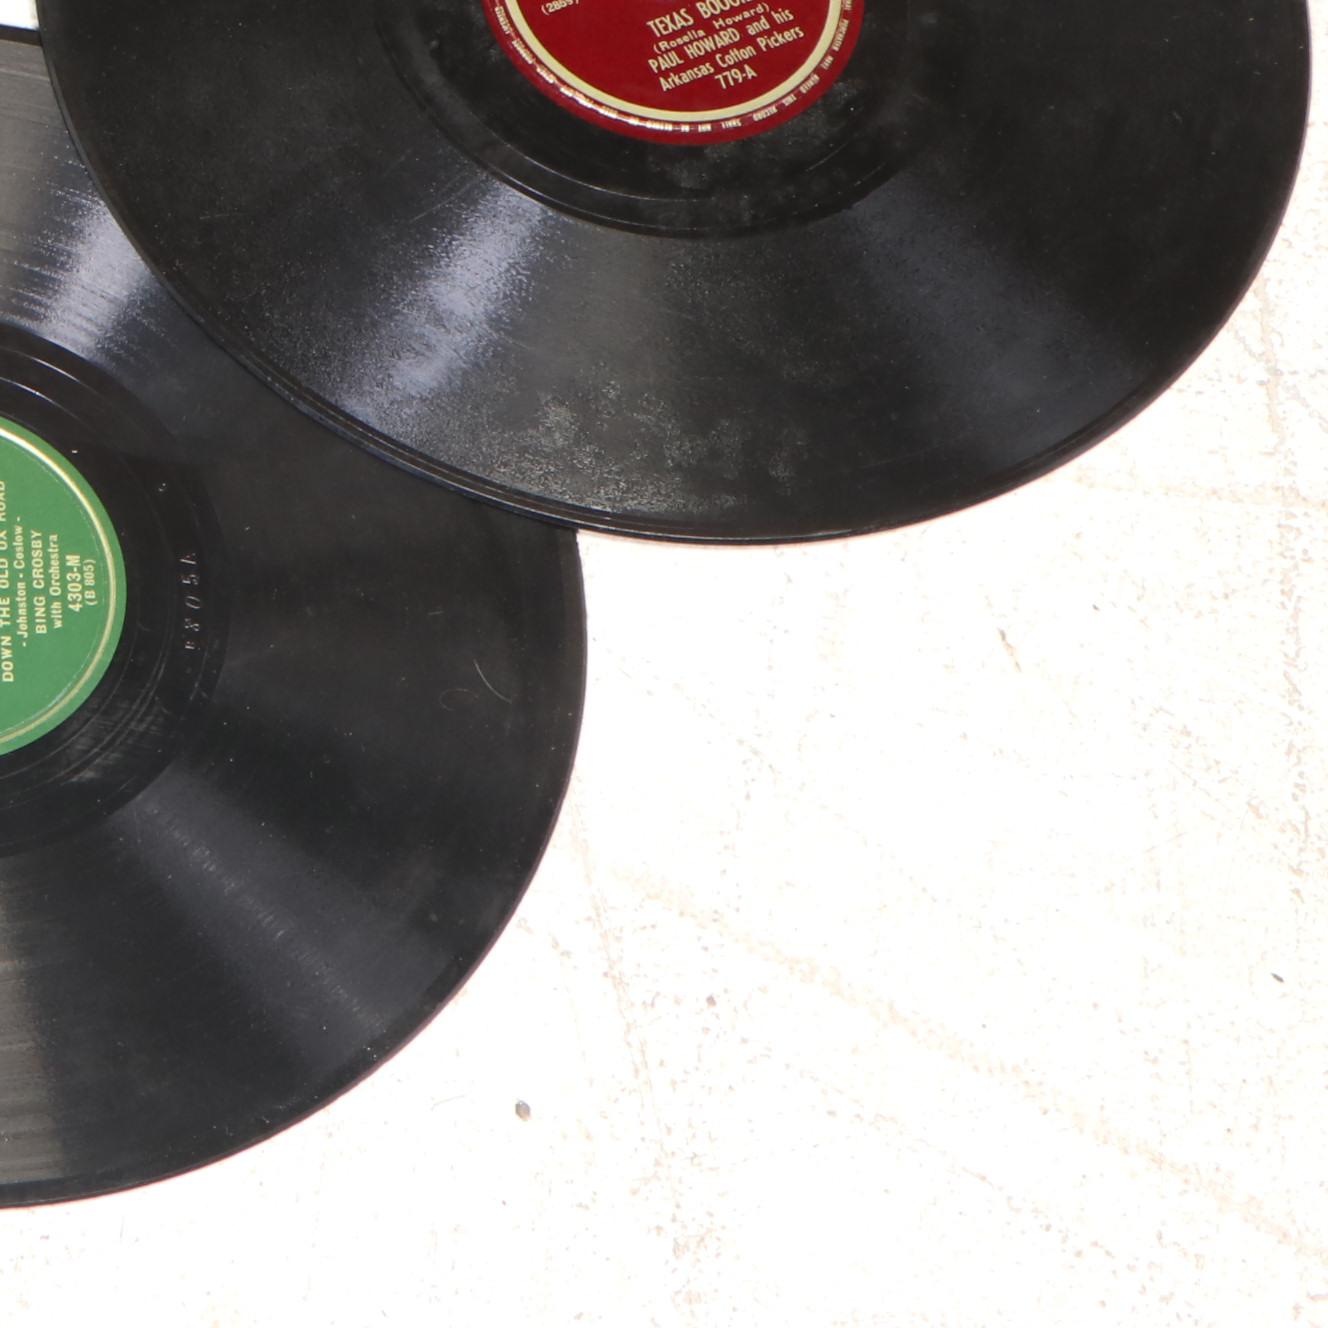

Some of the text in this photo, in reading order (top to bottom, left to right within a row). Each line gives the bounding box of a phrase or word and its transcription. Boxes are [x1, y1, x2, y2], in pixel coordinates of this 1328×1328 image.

[646, 8, 694, 38] TEXAS
[647, 8, 794, 73] PAUL HOWARD and his
[653, 2, 770, 54] (Rosella Howard)
[658, 26, 805, 92] Arkansas Cotton Pickers
[714, 64, 758, 90] 779-A
[12, 525, 28, 639] Johnston Coslow
[30, 530, 48, 634] BING CROSBY
[48, 534, 63, 629] with Orchestra
[66, 555, 83, 612] 4303-M
[0, 635, 14, 683] DOWN
